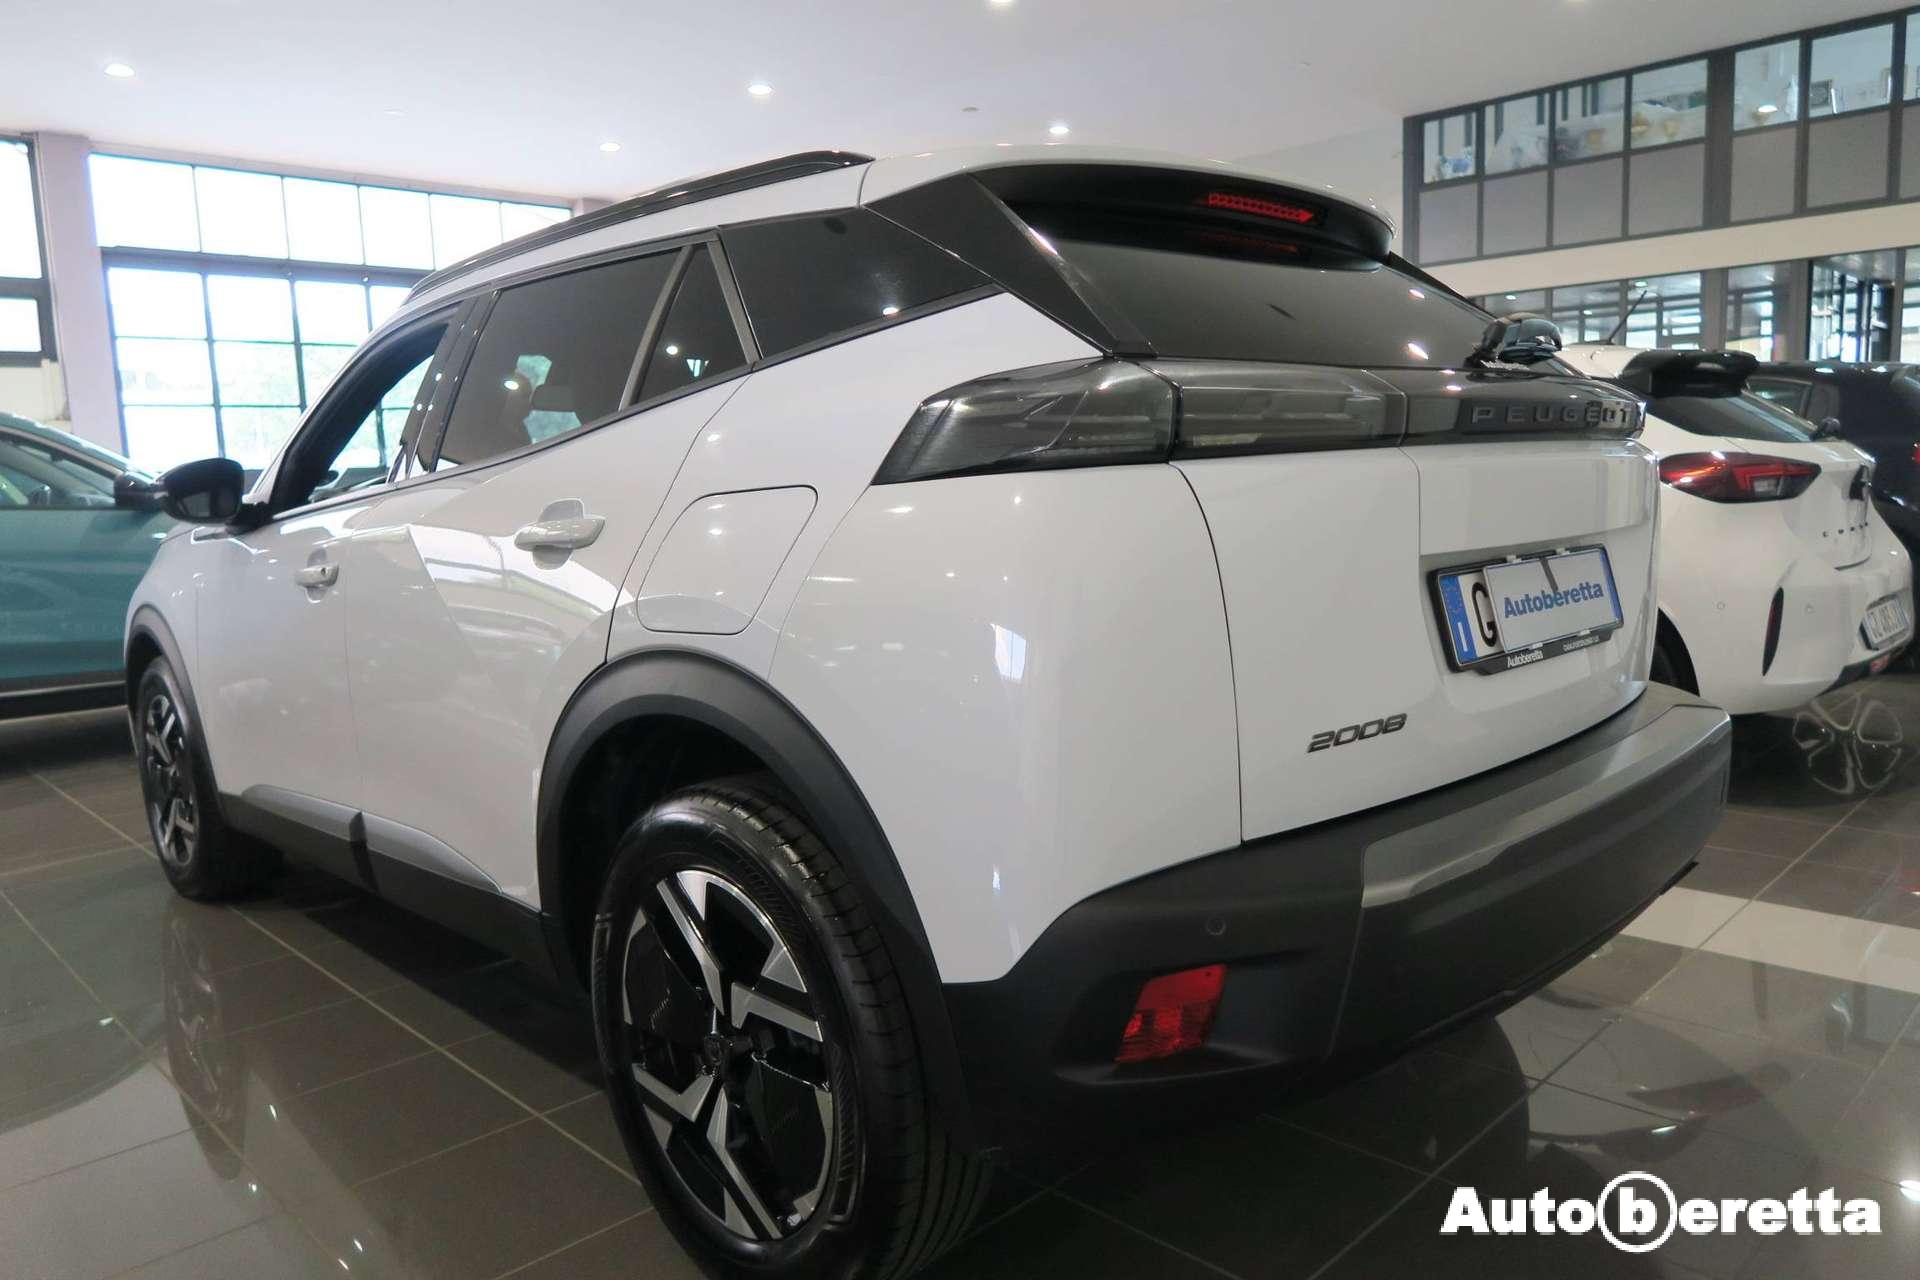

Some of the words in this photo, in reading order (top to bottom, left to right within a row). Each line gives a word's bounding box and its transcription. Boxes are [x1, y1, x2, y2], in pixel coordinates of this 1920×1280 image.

[1471, 404, 1632, 425] PEUGEOT
[1471, 582, 1497, 647] G
[1503, 581, 1604, 618] Autoberetta
[1306, 713, 1407, 753] 2008
